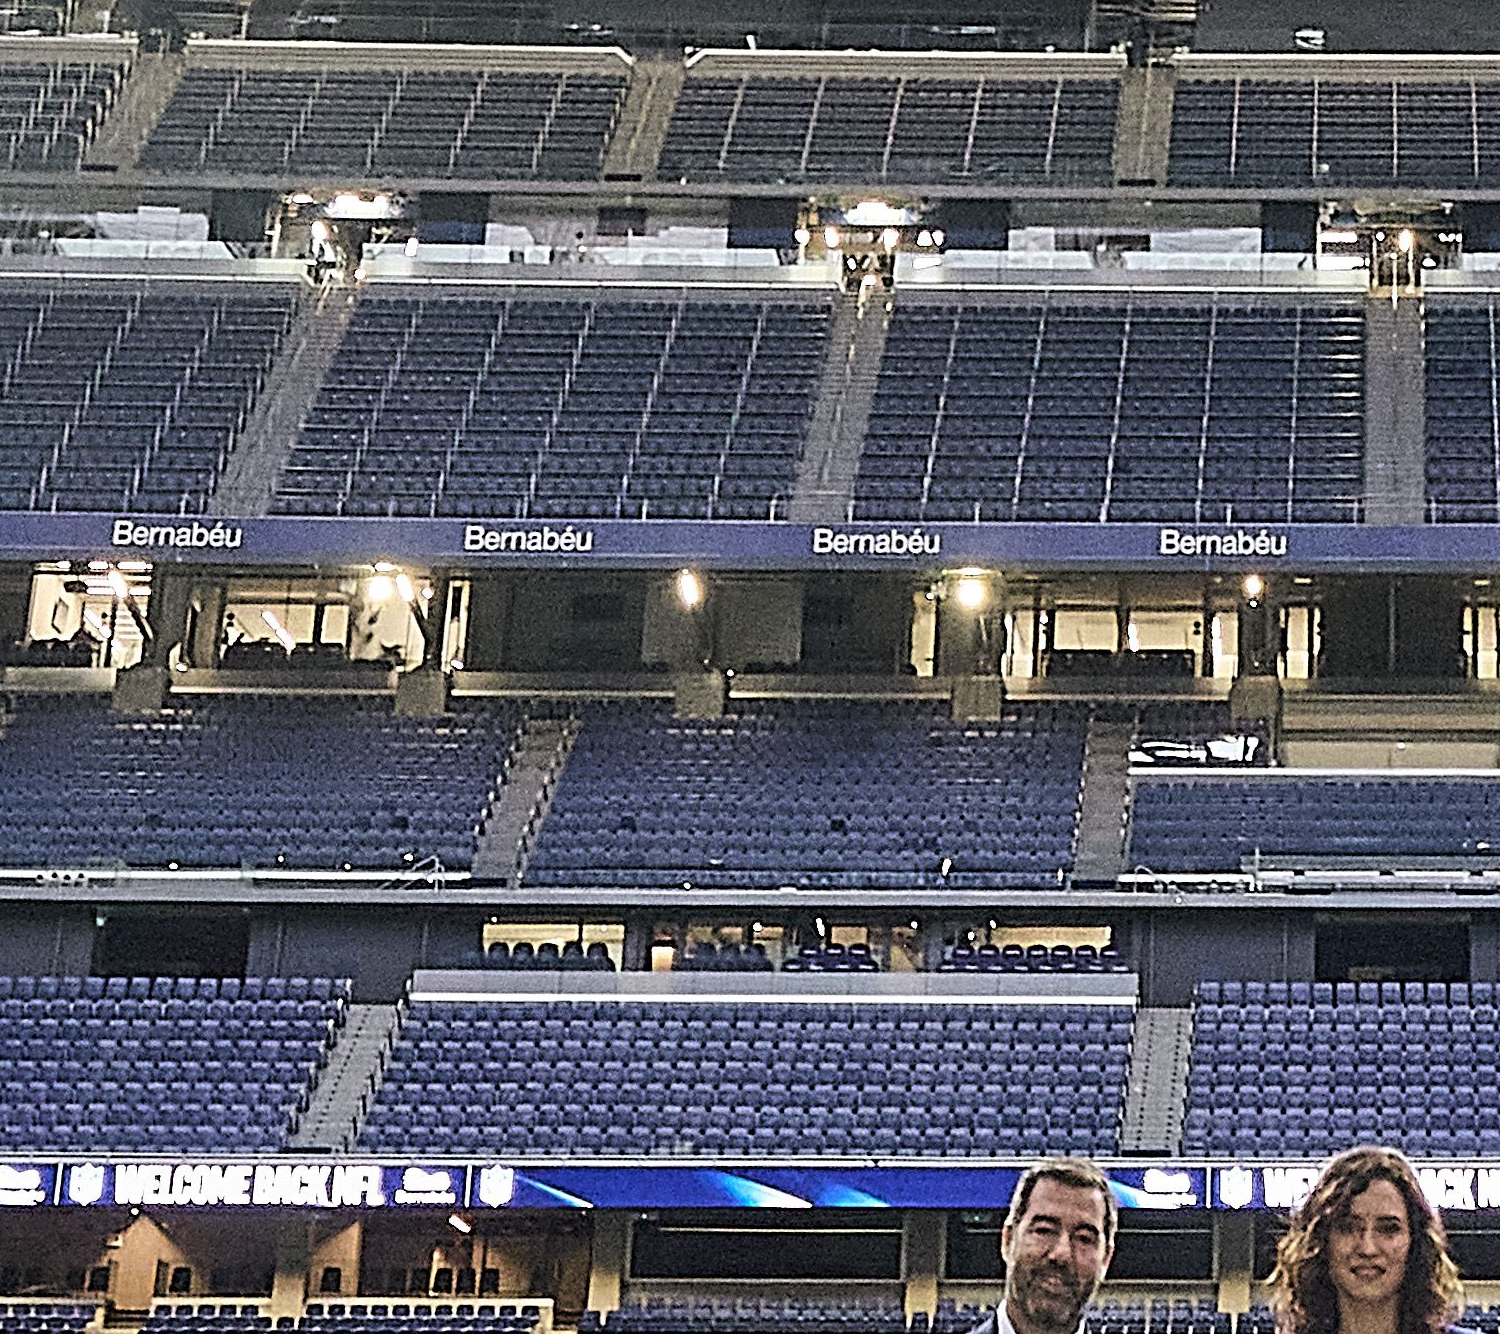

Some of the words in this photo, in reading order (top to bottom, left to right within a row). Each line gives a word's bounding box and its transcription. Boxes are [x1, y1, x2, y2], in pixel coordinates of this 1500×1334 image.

[111, 519, 243, 548] Bernabéu
[464, 524, 593, 551] Bernabéu
[812, 527, 941, 554] Bernabéu
[1159, 528, 1288, 555] Bernabéu
